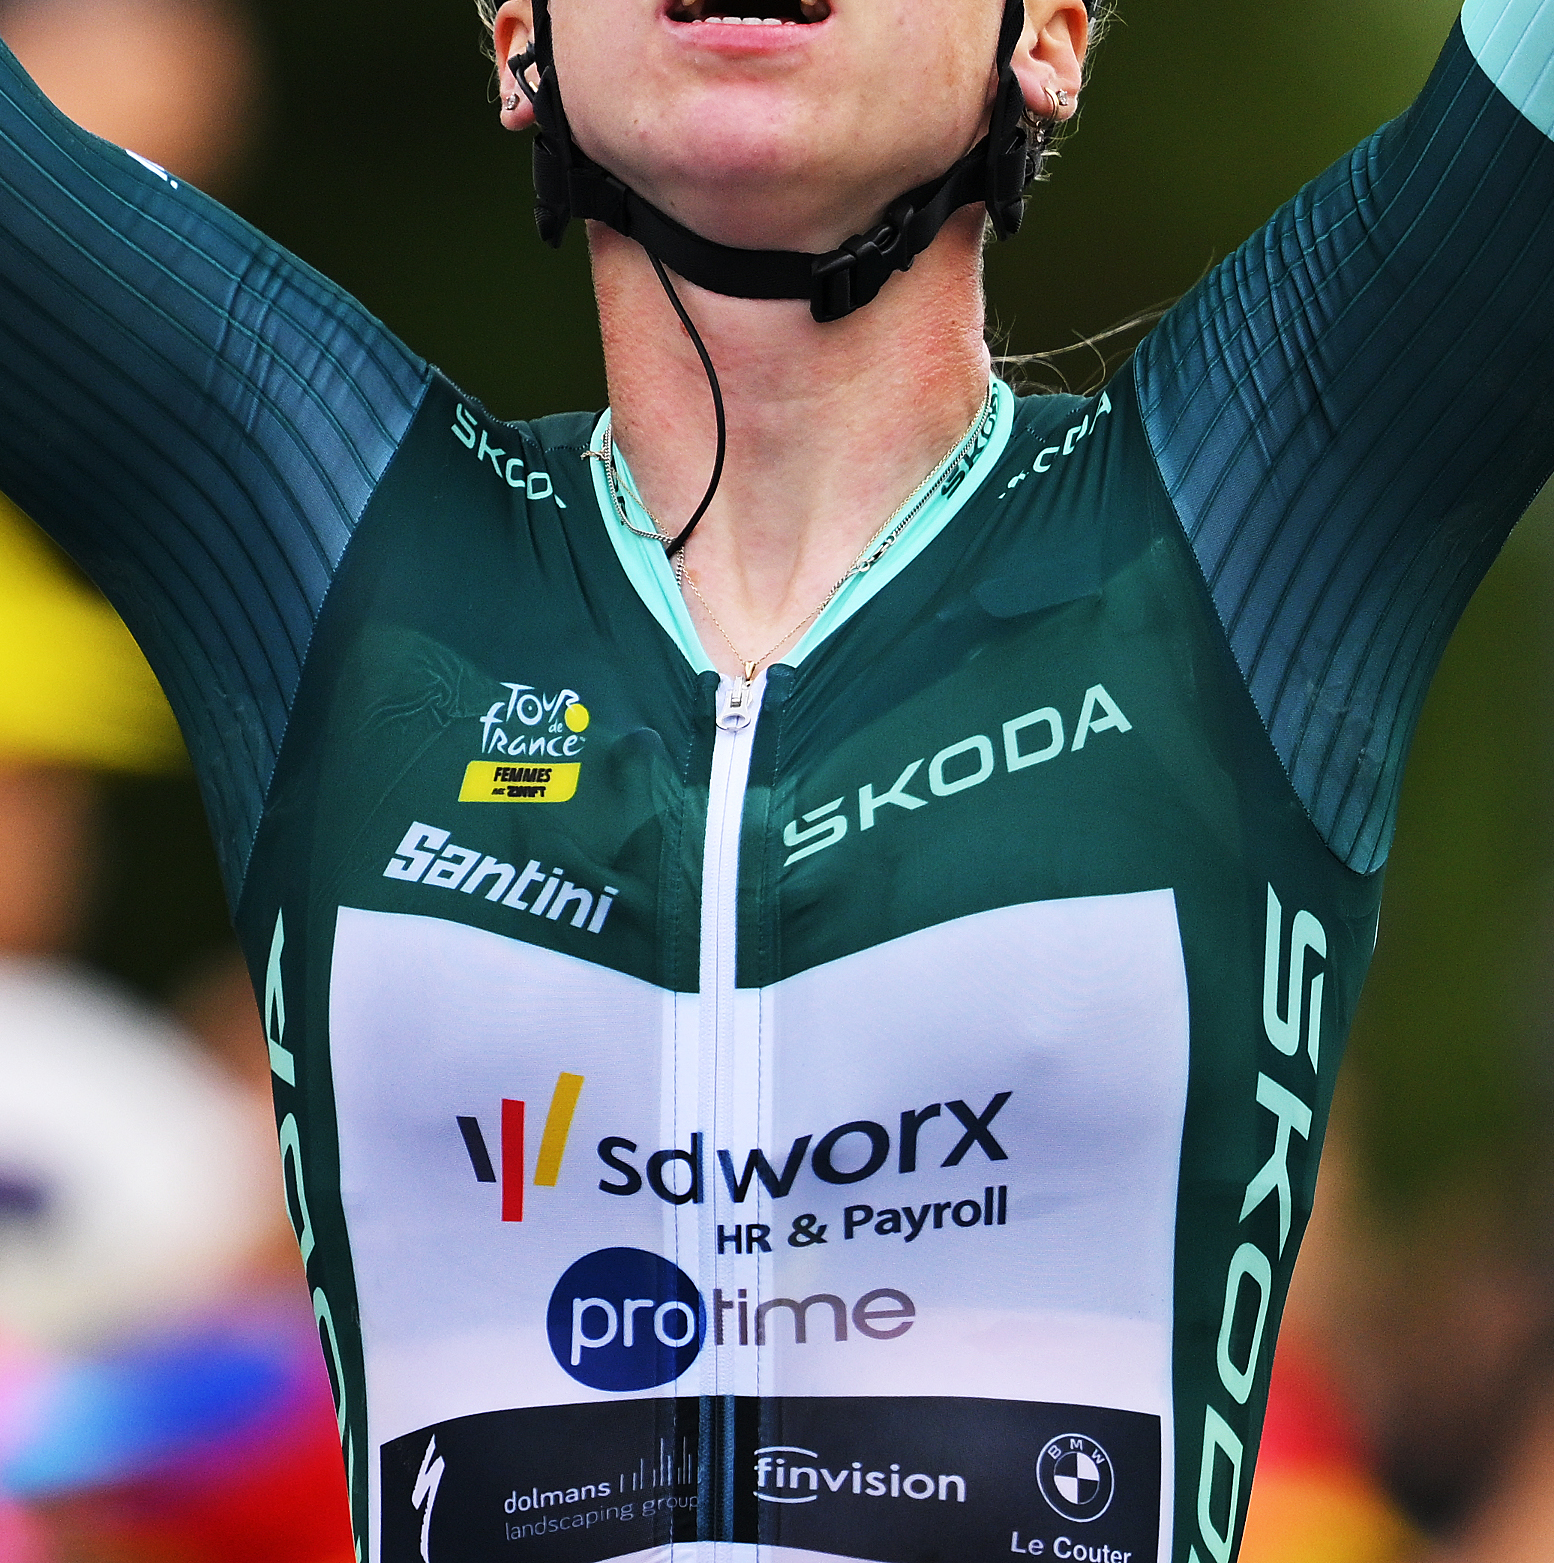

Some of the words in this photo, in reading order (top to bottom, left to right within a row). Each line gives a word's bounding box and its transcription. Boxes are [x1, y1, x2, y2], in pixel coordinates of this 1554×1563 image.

[548, 719, 563, 733] de
[493, 766, 552, 783] FEMMES
[783, 683, 1133, 867] SKODA
[383, 821, 620, 934] Santini
[716, 1223, 773, 1255] HR
[788, 1213, 827, 1248] &
[844, 1185, 1008, 1242] Payroll
[570, 1287, 917, 1366] protime
[1047, 1438, 1106, 1465] BMW
[504, 1481, 612, 1515] dolmans
[754, 1457, 966, 1503] finvision
[505, 1503, 634, 1541] landscaping
[1010, 1531, 1044, 1556] Le
[1053, 1535, 1133, 1563] Couter
